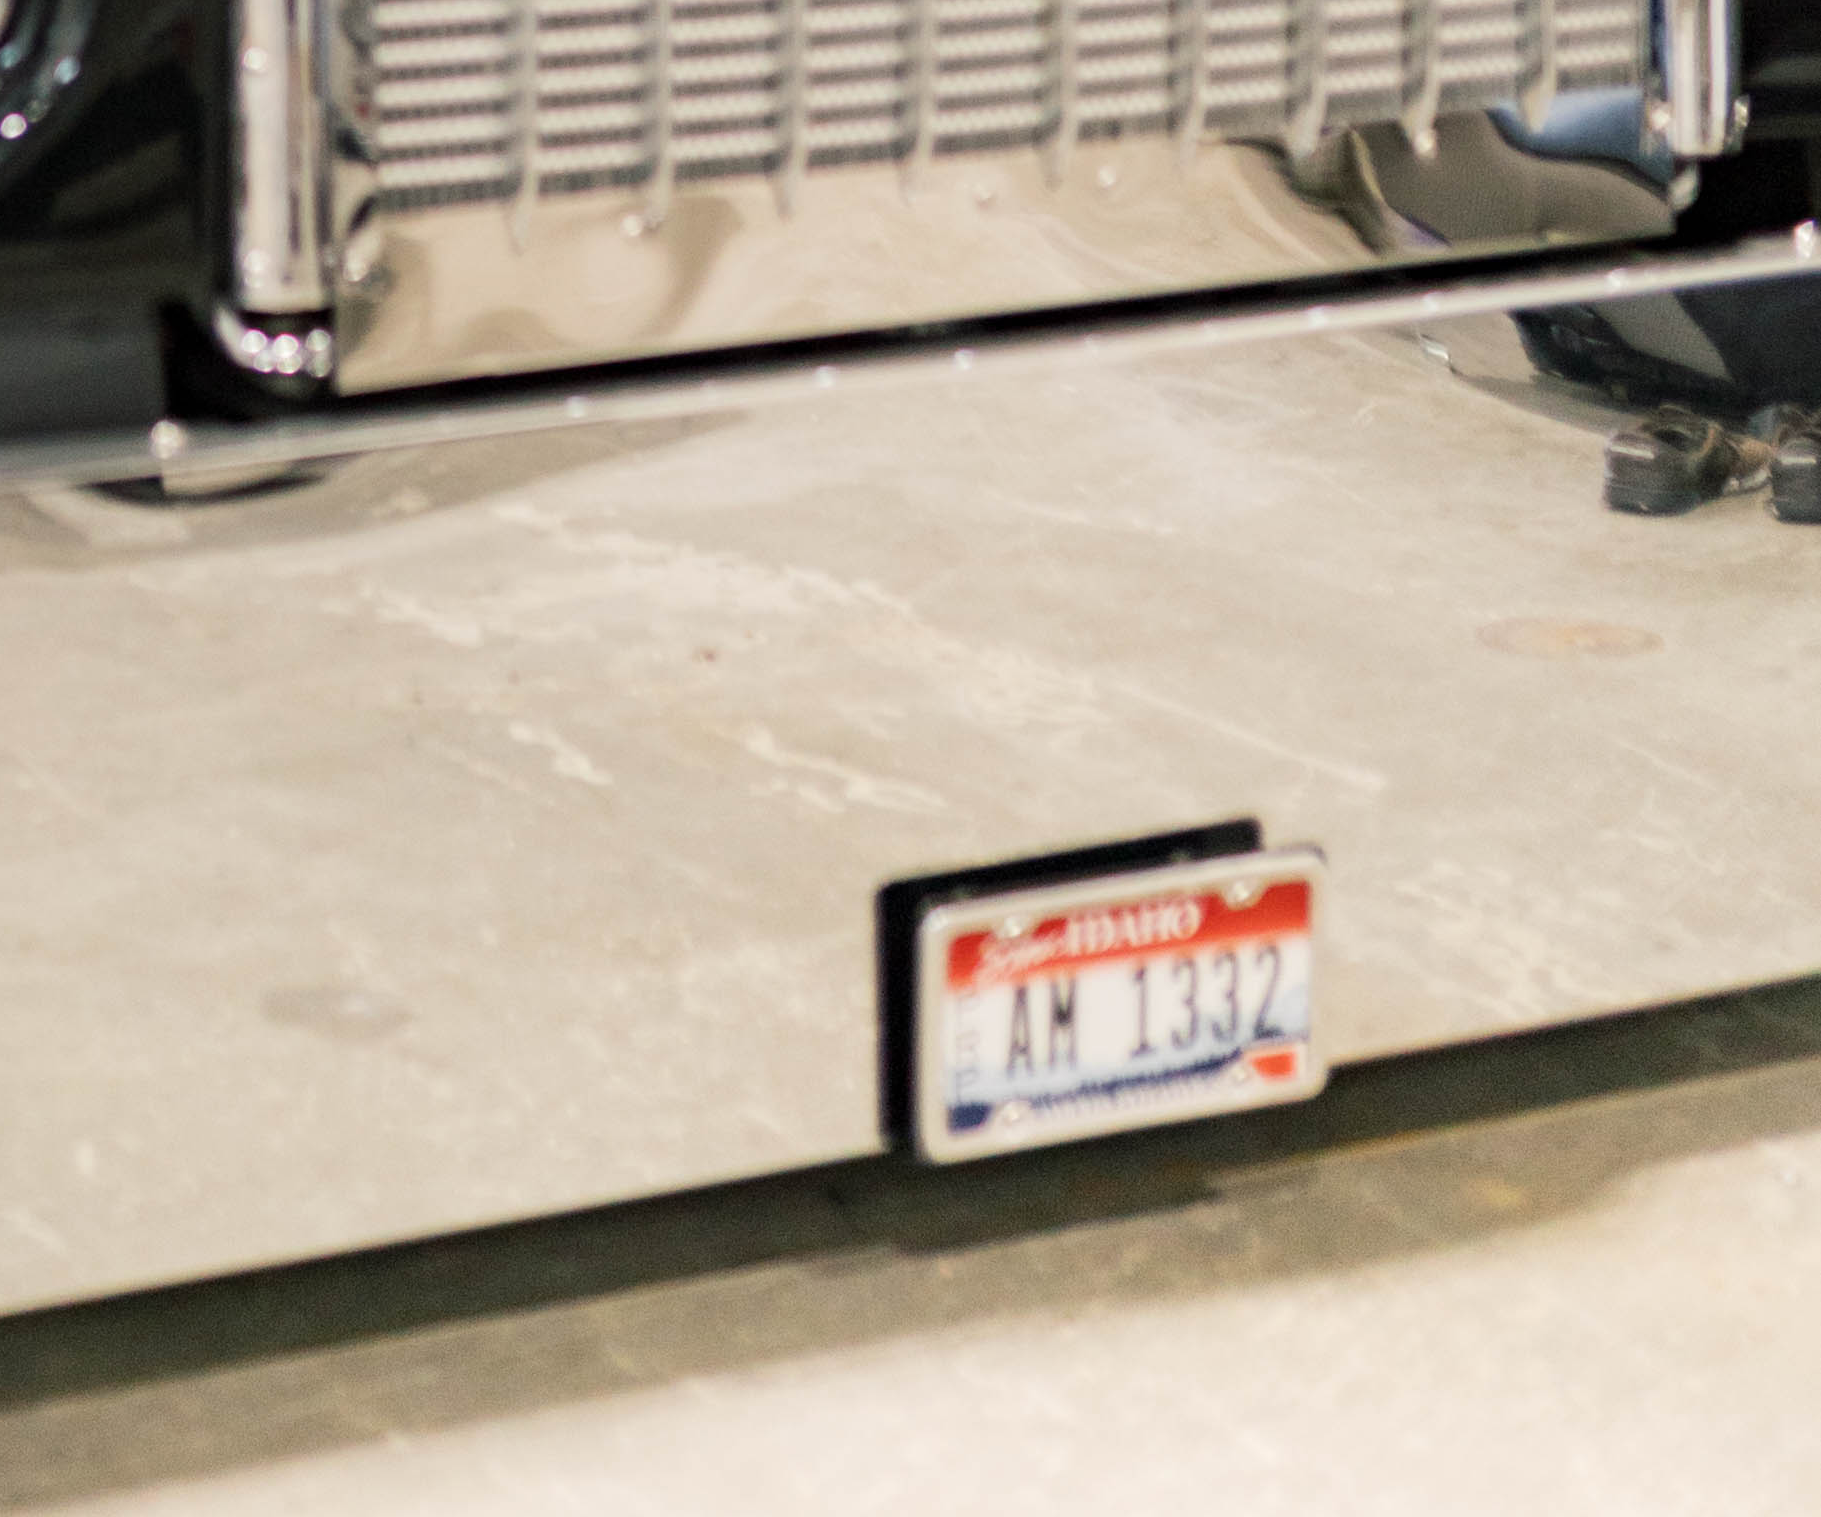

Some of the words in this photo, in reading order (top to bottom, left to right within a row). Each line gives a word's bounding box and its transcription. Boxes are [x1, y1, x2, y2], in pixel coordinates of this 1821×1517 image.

[1067, 898, 1202, 957] IDAHO
[1006, 971, 1078, 1081] AM
[1130, 943, 1284, 1057] 1332
